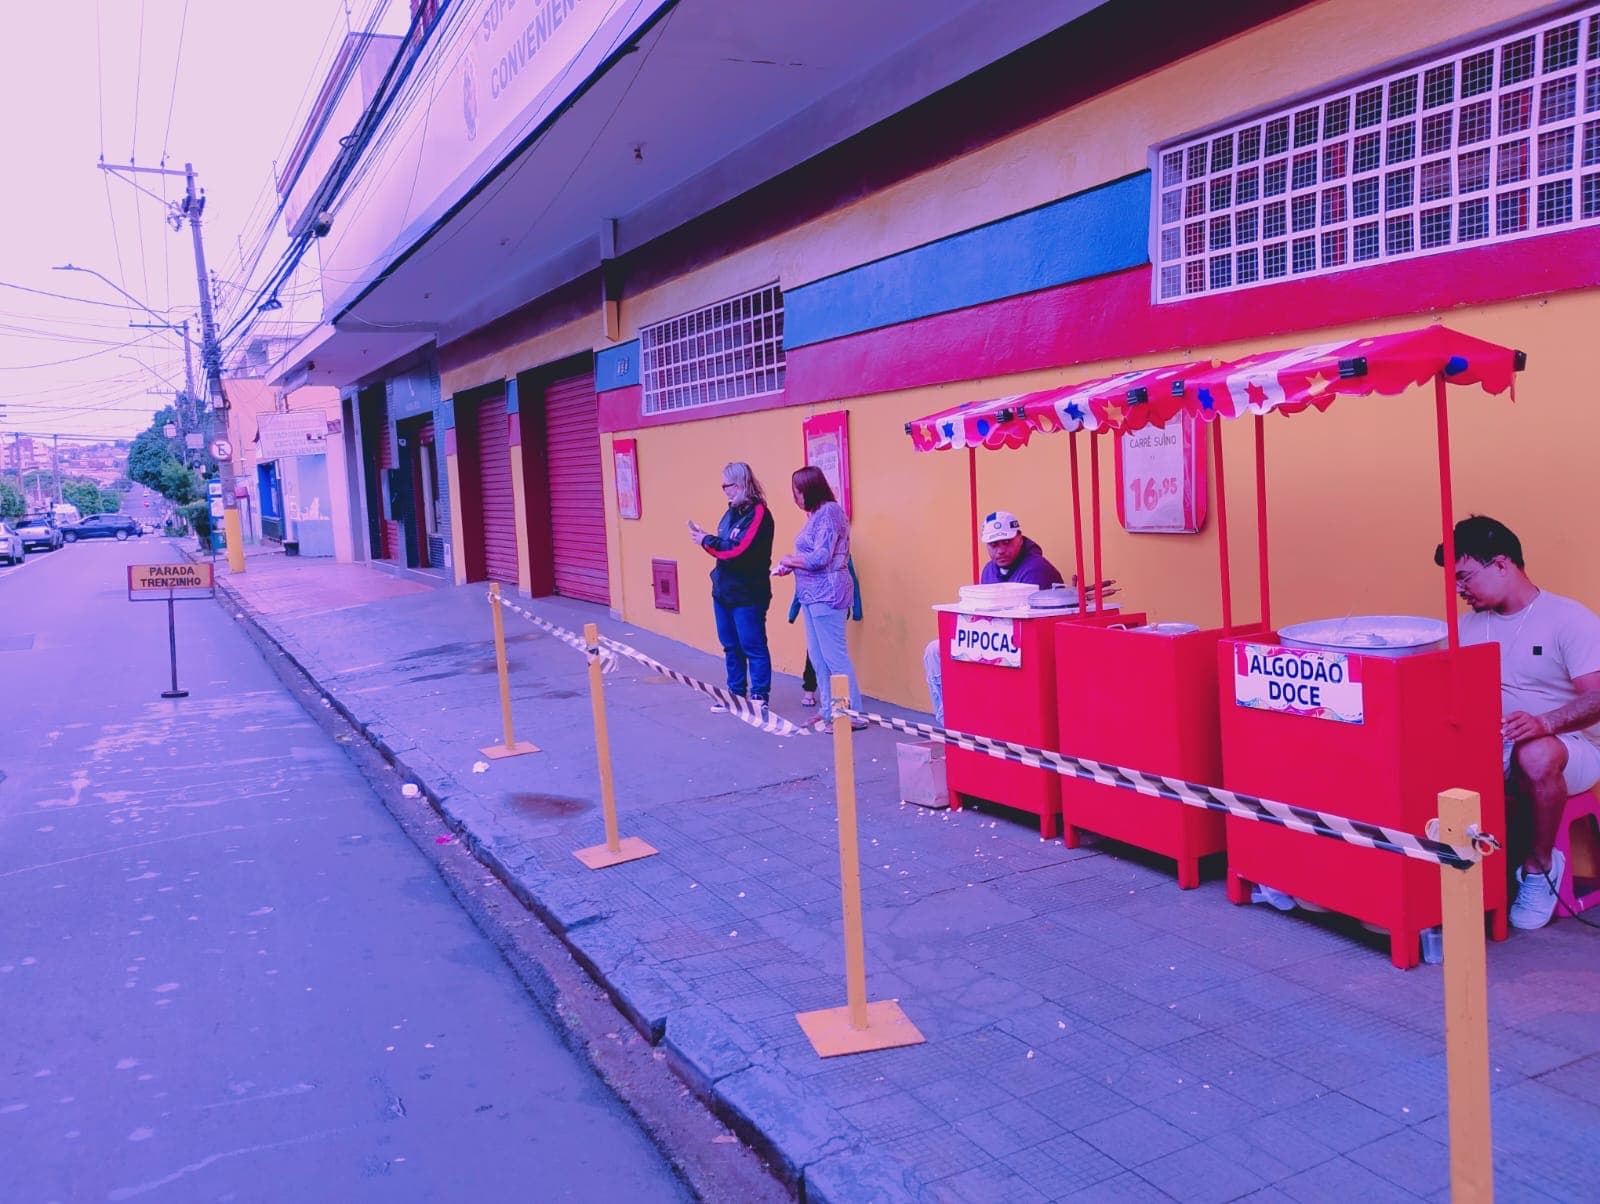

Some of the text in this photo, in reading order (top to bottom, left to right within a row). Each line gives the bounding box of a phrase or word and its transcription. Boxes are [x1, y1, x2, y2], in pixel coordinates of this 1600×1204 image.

[1129, 433, 1177, 449] CARRÉ SUÍNO
[149, 566, 195, 576] PARADA
[140, 577, 201, 588] TRENZINHO
[1250, 655, 1343, 684] ALGODÃO
[1269, 681, 1321, 706] DOCE
